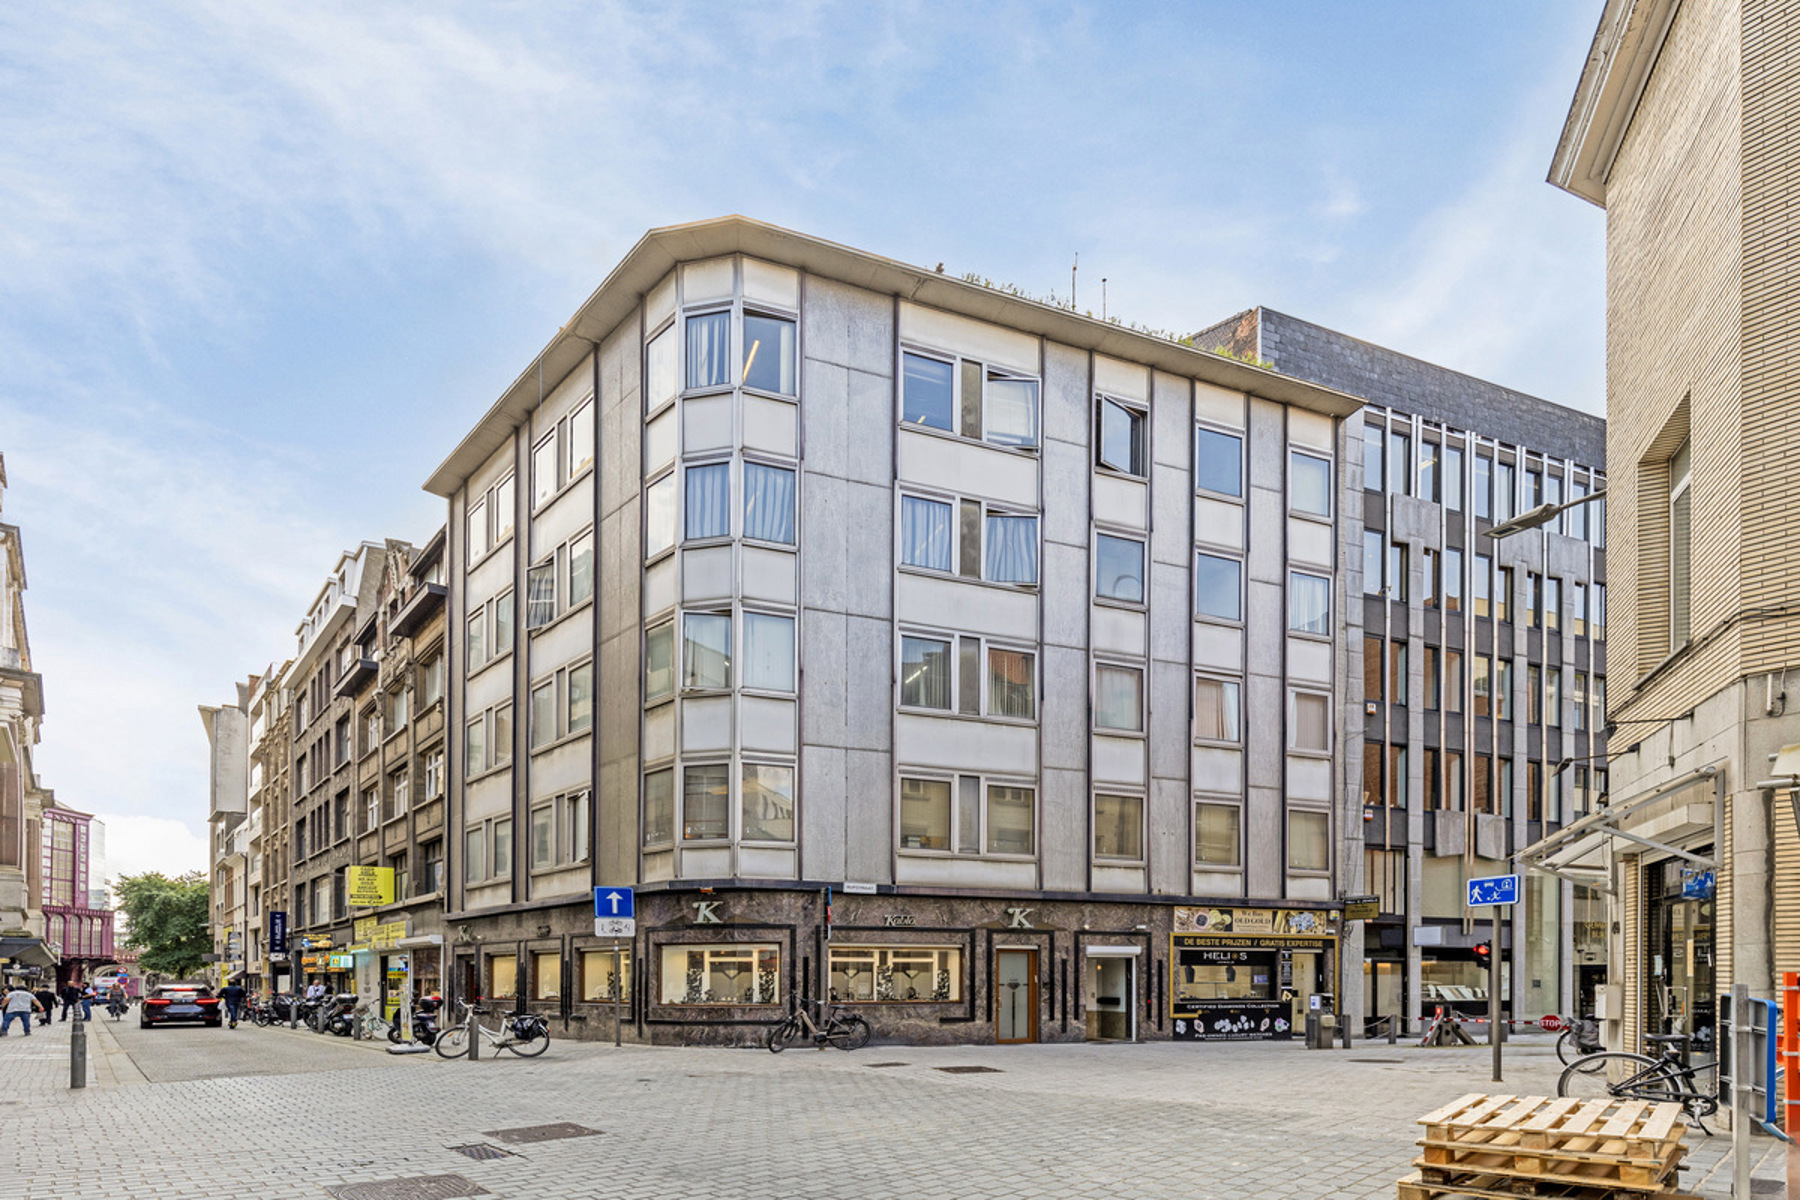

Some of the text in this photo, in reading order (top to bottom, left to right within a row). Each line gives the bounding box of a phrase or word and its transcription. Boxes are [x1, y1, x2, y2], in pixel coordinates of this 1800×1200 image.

[692, 901, 723, 924] K
[1007, 907, 1034, 928] K
[1184, 937, 1195, 945] DE
[1196, 938, 1219, 946] BESTE
[1221, 938, 1251, 946] PRIJZEN
[1260, 939, 1285, 947] GRATIS
[1539, 1019, 1561, 1028] STOP
